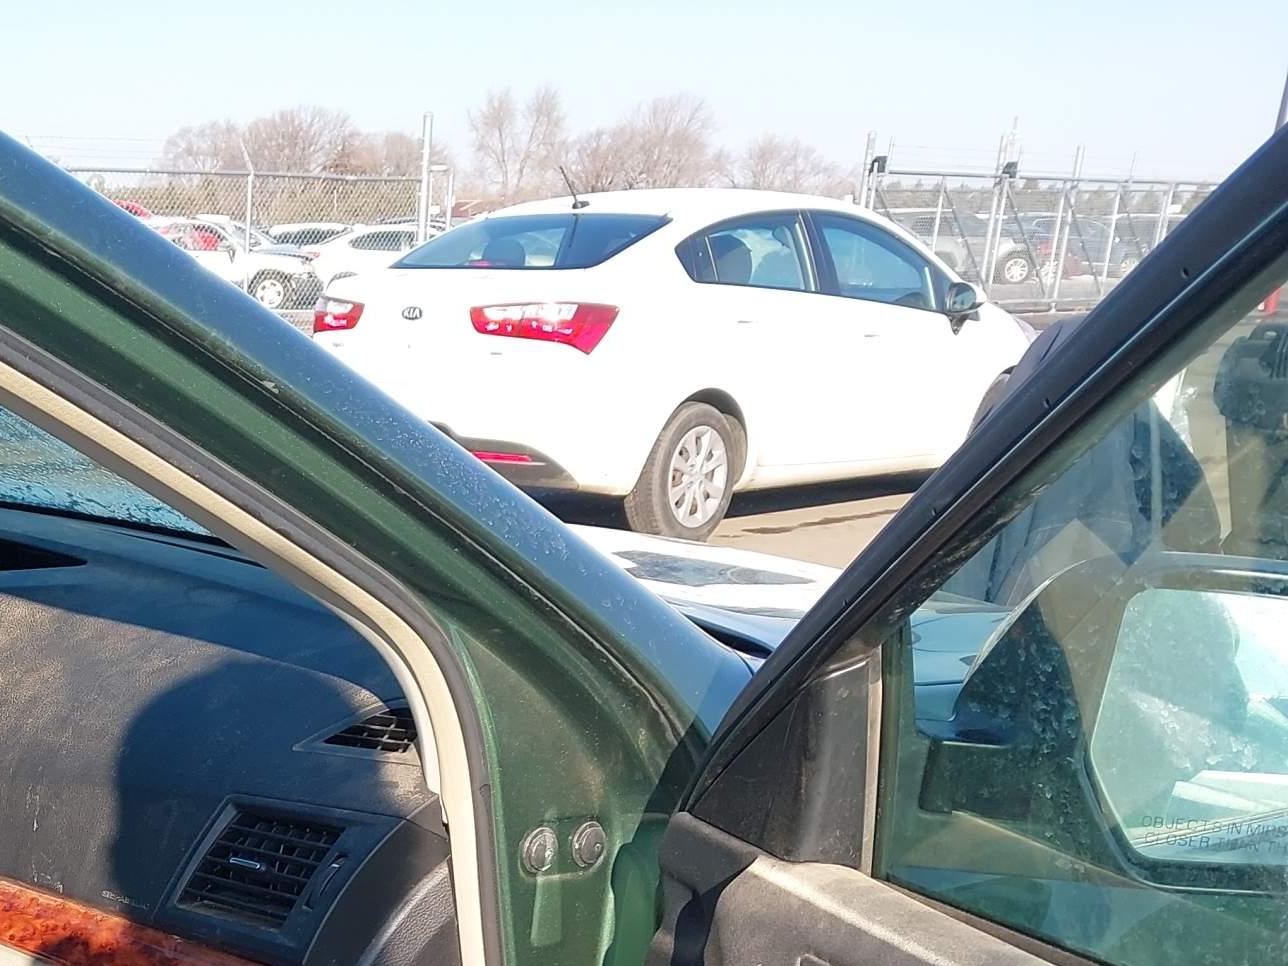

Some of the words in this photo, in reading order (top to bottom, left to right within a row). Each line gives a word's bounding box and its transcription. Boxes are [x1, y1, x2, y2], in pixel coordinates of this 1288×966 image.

[403, 307, 421, 319] KIA
[1142, 815, 1222, 832] OBJECTS
[1226, 822, 1242, 835] IN
[1144, 831, 1211, 848] CLOSER
